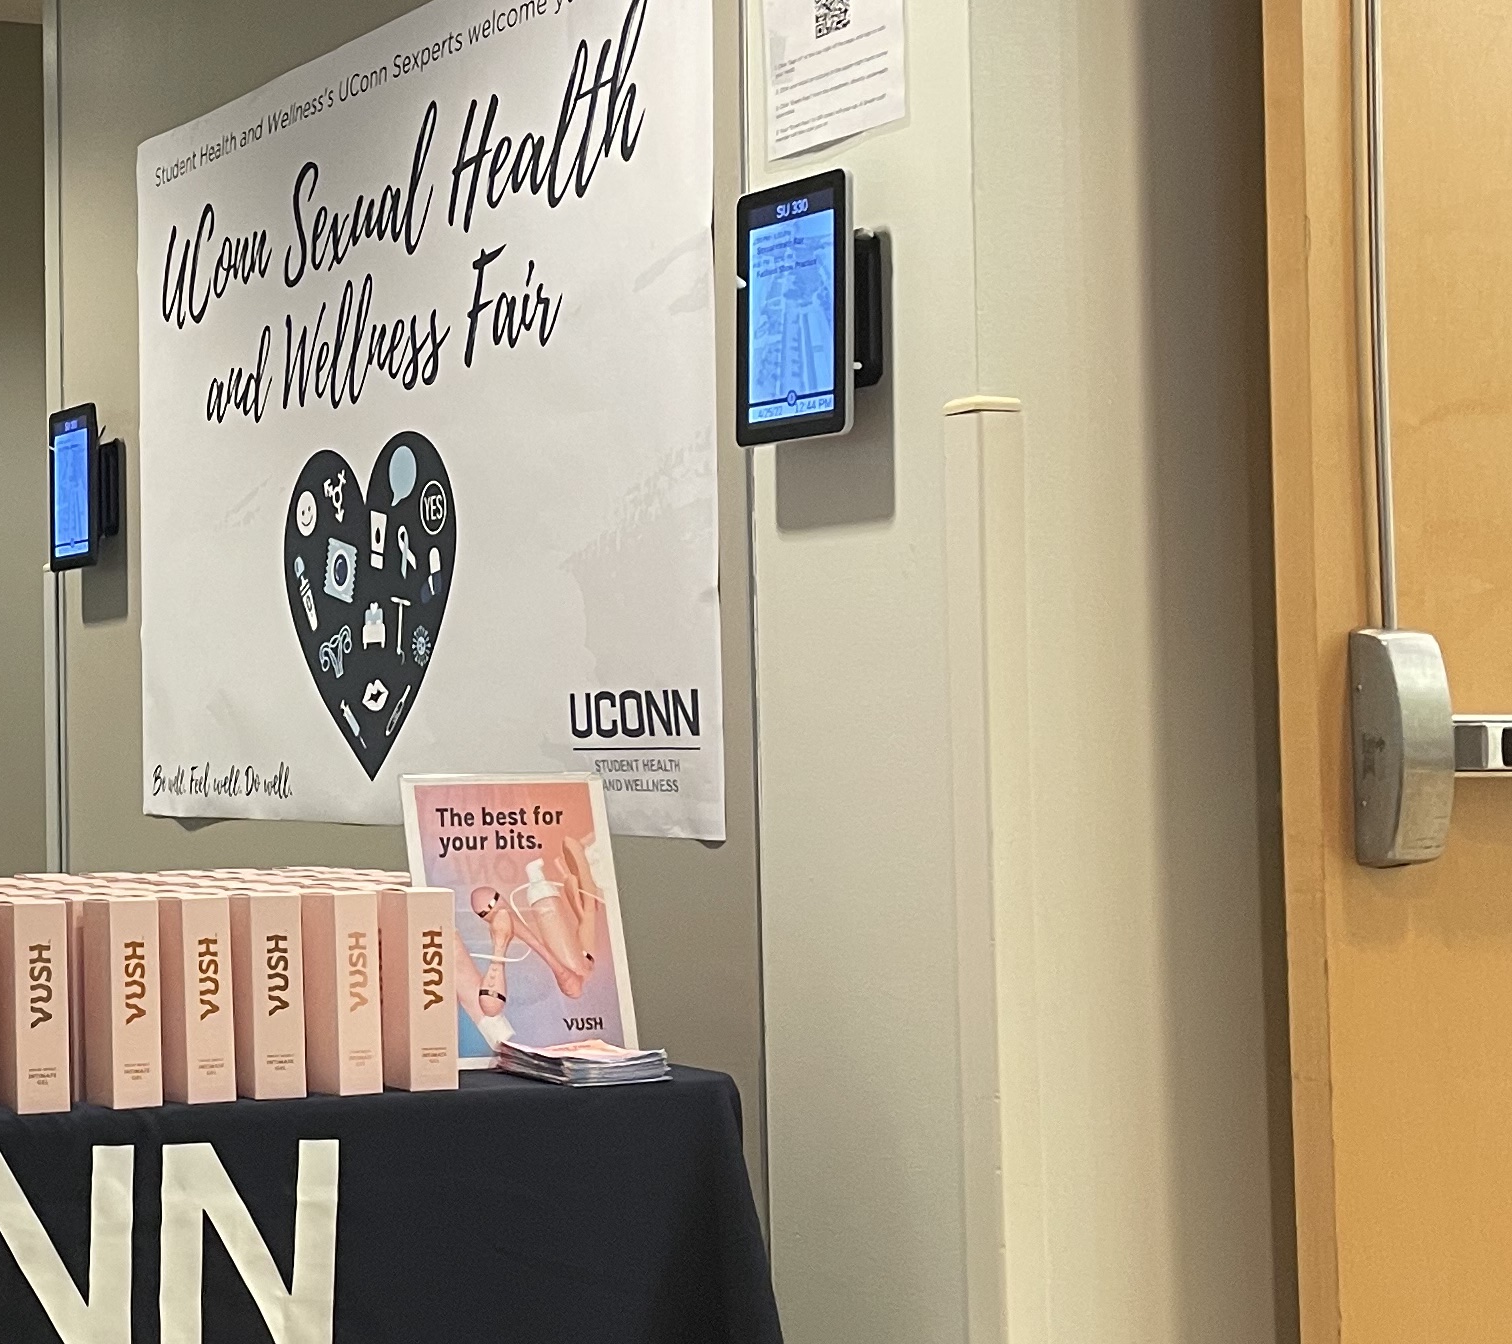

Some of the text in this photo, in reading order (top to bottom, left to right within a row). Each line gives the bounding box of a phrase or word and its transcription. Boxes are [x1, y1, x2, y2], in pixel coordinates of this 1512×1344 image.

[155, 151, 197, 188] Student
[199, 132, 237, 166] Health
[239, 117, 263, 148] and
[267, 87, 334, 134] Wellness's
[338, 65, 388, 102] UConn
[392, 31, 463, 79] Sexperts
[161, 202, 273, 330] UConn
[284, 101, 437, 288] Sexual
[776, 201, 789, 219] SU
[206, 243, 563, 423] and Wellness Fair
[424, 495, 443, 521] YES
[570, 688, 700, 738] UCONN
[152, 764, 166, 796] Be
[189, 761, 210, 797] Feel
[245, 765, 260, 796] Do
[594, 758, 681, 772] STUDENT HEALTH
[603, 778, 679, 792] AND WELLNESS
[436, 806, 563, 827] The best for
[439, 829, 543, 858] your bits.
[28, 943, 53, 1029] VUSH
[124, 940, 146, 1025] VUSH
[197, 937, 220, 1021] VUSH
[266, 934, 289, 1017] VUSH
[347, 931, 369, 1013] VUSH
[422, 930, 444, 1011] VUSH
[563, 1017, 604, 1031] VUSH
